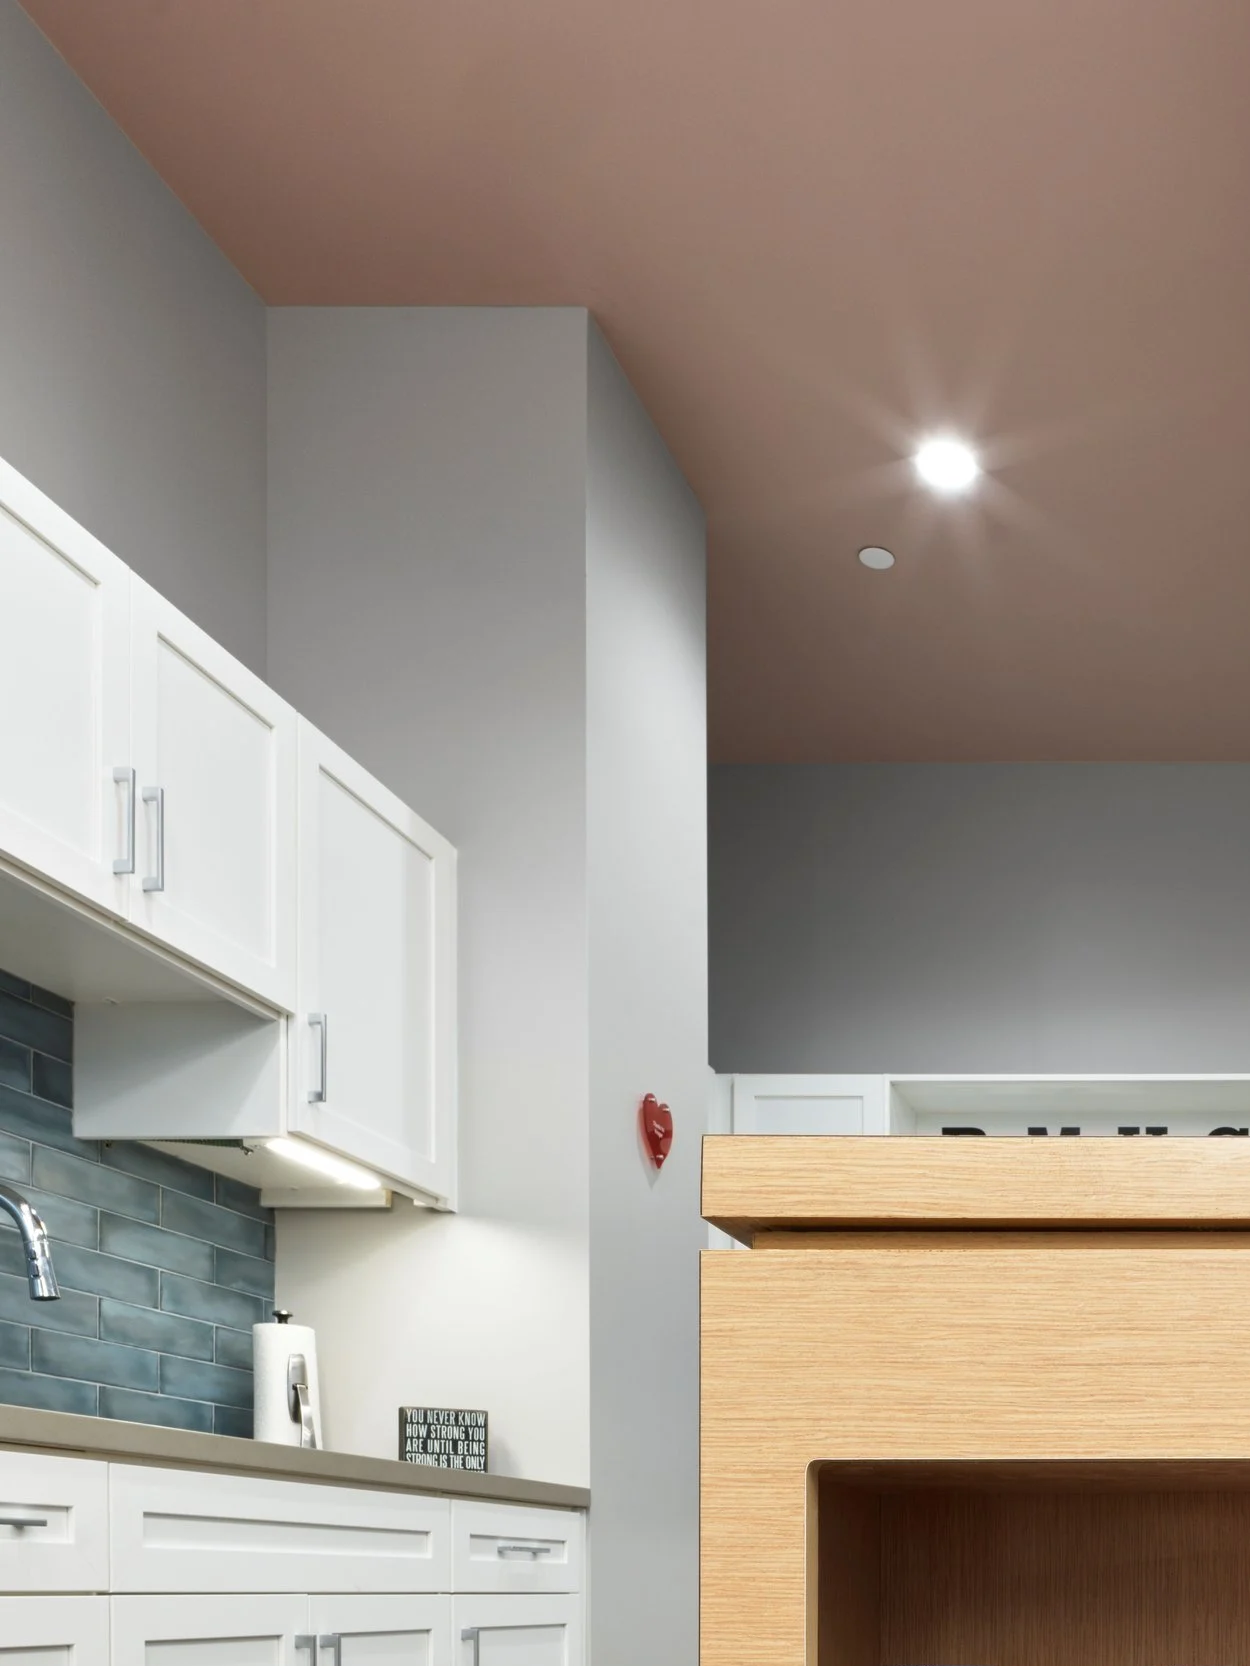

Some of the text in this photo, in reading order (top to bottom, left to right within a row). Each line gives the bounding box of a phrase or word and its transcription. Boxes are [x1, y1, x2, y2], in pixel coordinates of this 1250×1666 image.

[406, 1408, 485, 1426] YOU NEVER KNOW
[406, 1423, 485, 1441] HOW STRONG YOU
[406, 1438, 485, 1455] ARE UNTIL BEING
[406, 1453, 485, 1469] STRONG IS THE ONLY
